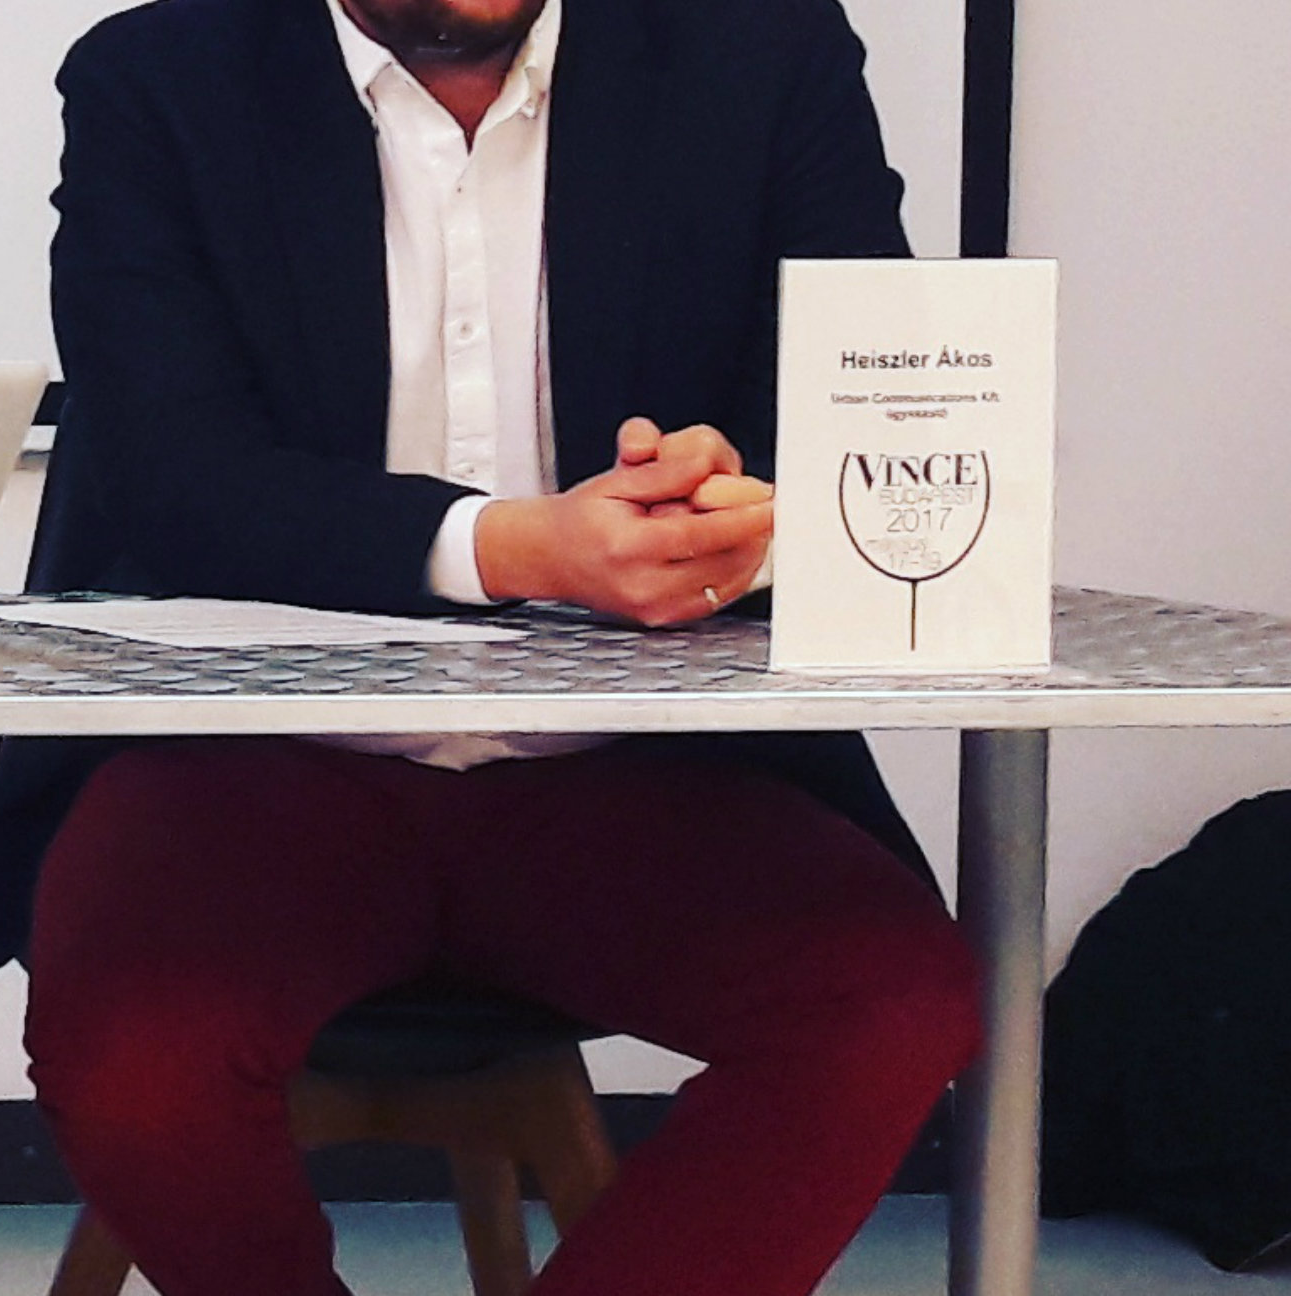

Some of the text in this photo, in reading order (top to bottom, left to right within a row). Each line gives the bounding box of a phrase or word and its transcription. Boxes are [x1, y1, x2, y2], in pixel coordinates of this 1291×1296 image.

[841, 344, 992, 369] Heiszler Ákos
[886, 507, 953, 532] 2017
